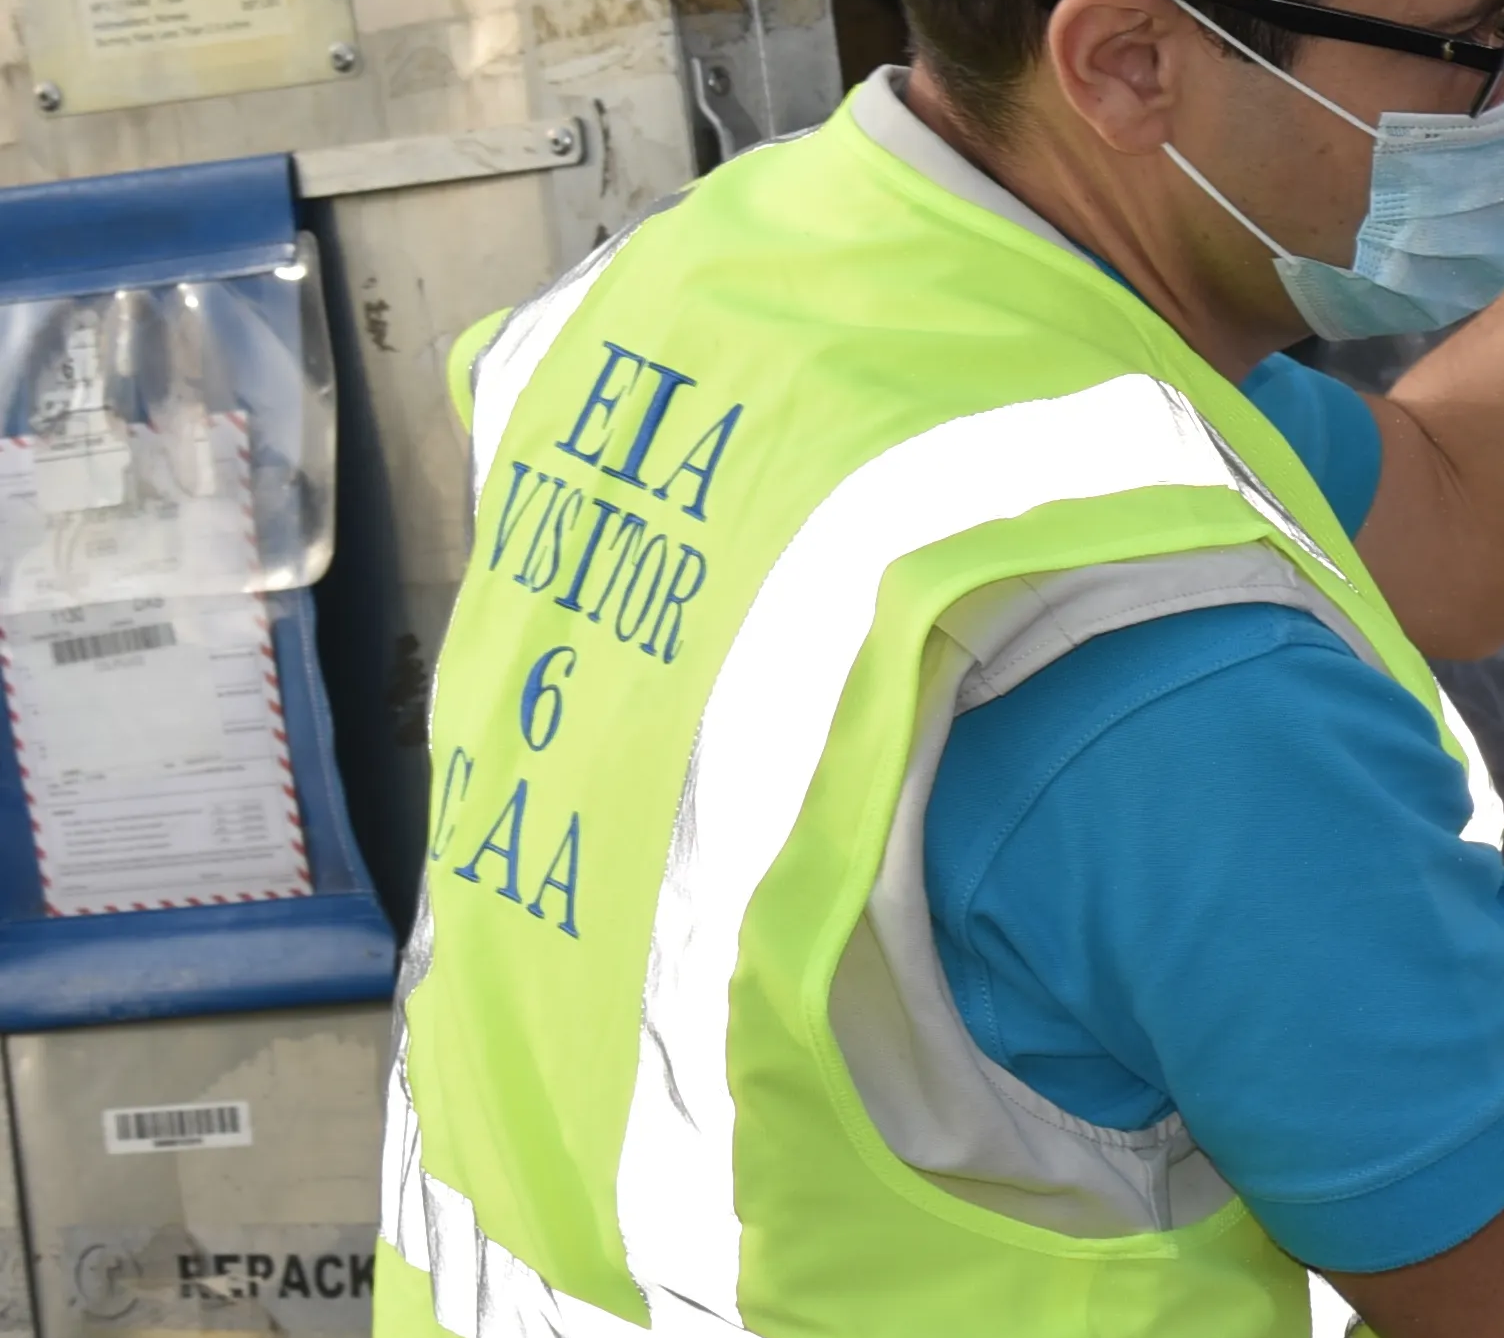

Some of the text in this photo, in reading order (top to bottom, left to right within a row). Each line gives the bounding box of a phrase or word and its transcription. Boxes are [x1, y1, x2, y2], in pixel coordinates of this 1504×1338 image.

[555, 340, 745, 523] EIA
[487, 461, 707, 665] VISITOR
[518, 644, 575, 752] 6
